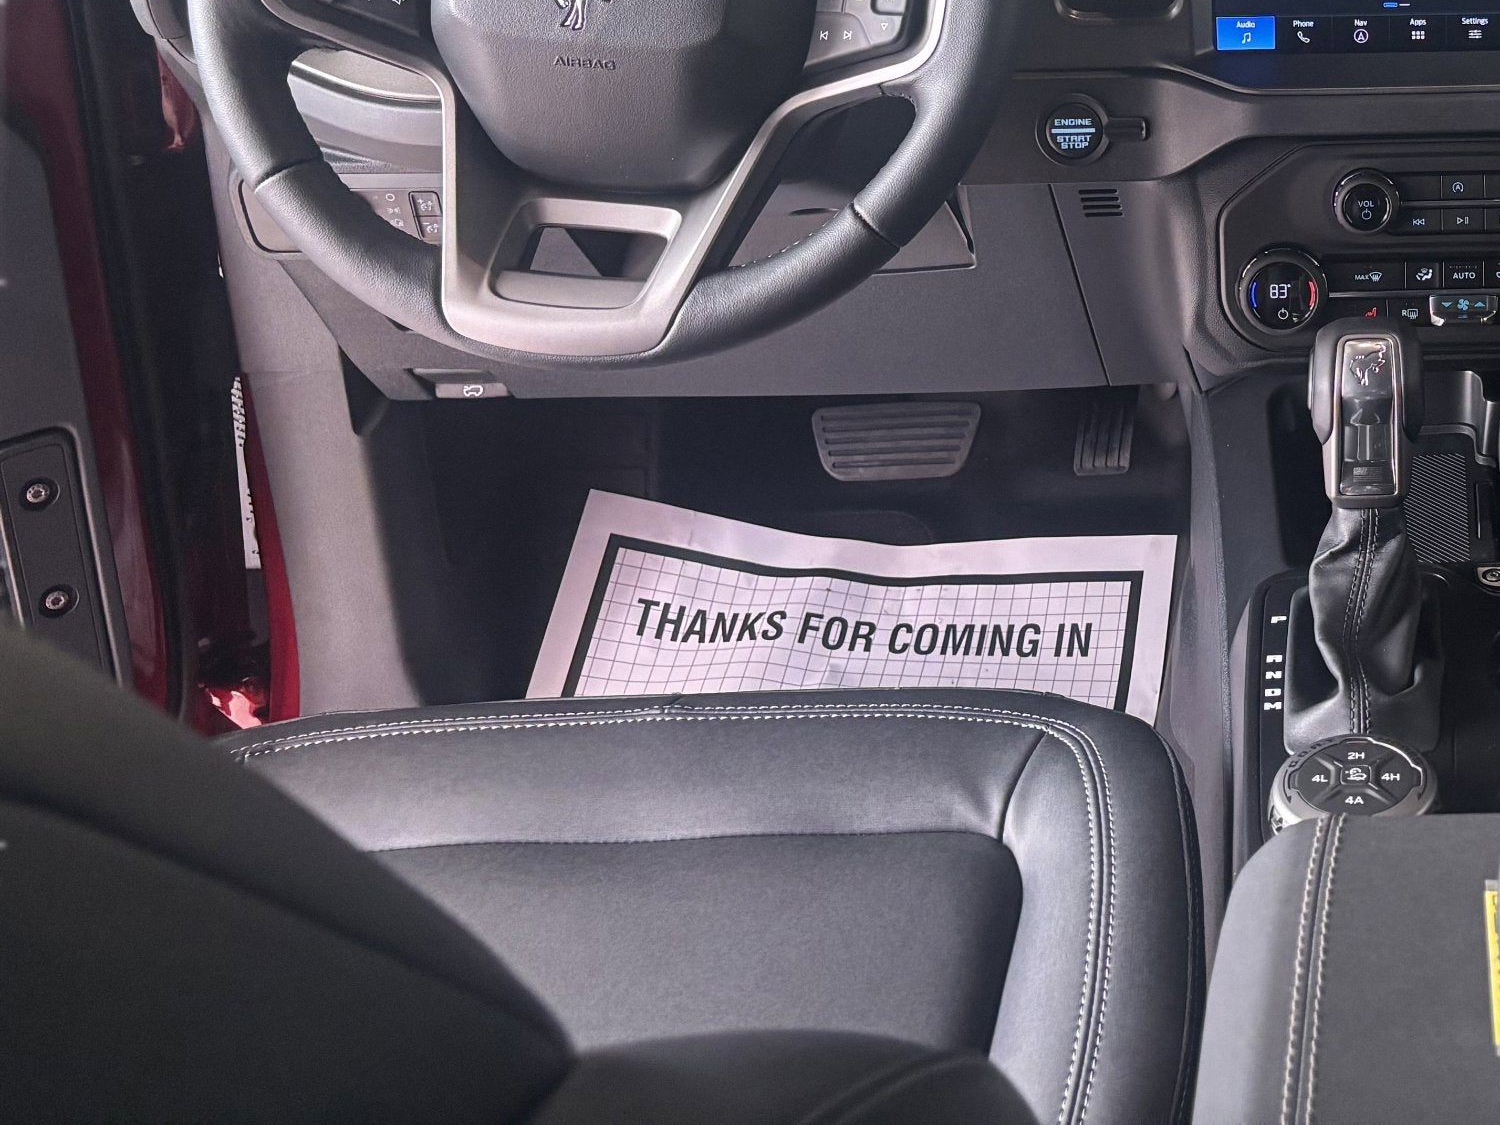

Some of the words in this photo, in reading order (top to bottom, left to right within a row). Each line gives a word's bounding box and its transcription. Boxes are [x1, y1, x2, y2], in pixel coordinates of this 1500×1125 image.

[1236, 20, 1256, 30] Audio
[1293, 19, 1314, 29] Phone
[1354, 18, 1368, 28] Nav
[1410, 17, 1427, 29] Apps
[1462, 17, 1489, 29] Settings
[553, 55, 616, 71] AIRBAG
[1054, 118, 1092, 126] ENGINE
[1358, 200, 1374, 208] VOL
[1452, 271, 1476, 279] AUTO
[1271, 615, 1287, 623] P
[636, 598, 787, 644] THANKS
[797, 612, 878, 654] FOR
[888, 622, 1041, 658] COMING
[1053, 622, 1093, 658] IN
[1266, 671, 1282, 679] N
[1264, 701, 1282, 711] M
[1347, 751, 1365, 760] 2H
[1312, 775, 1328, 783] 4L
[1381, 773, 1400, 781] 4H
[1344, 795, 1364, 805] 4A
